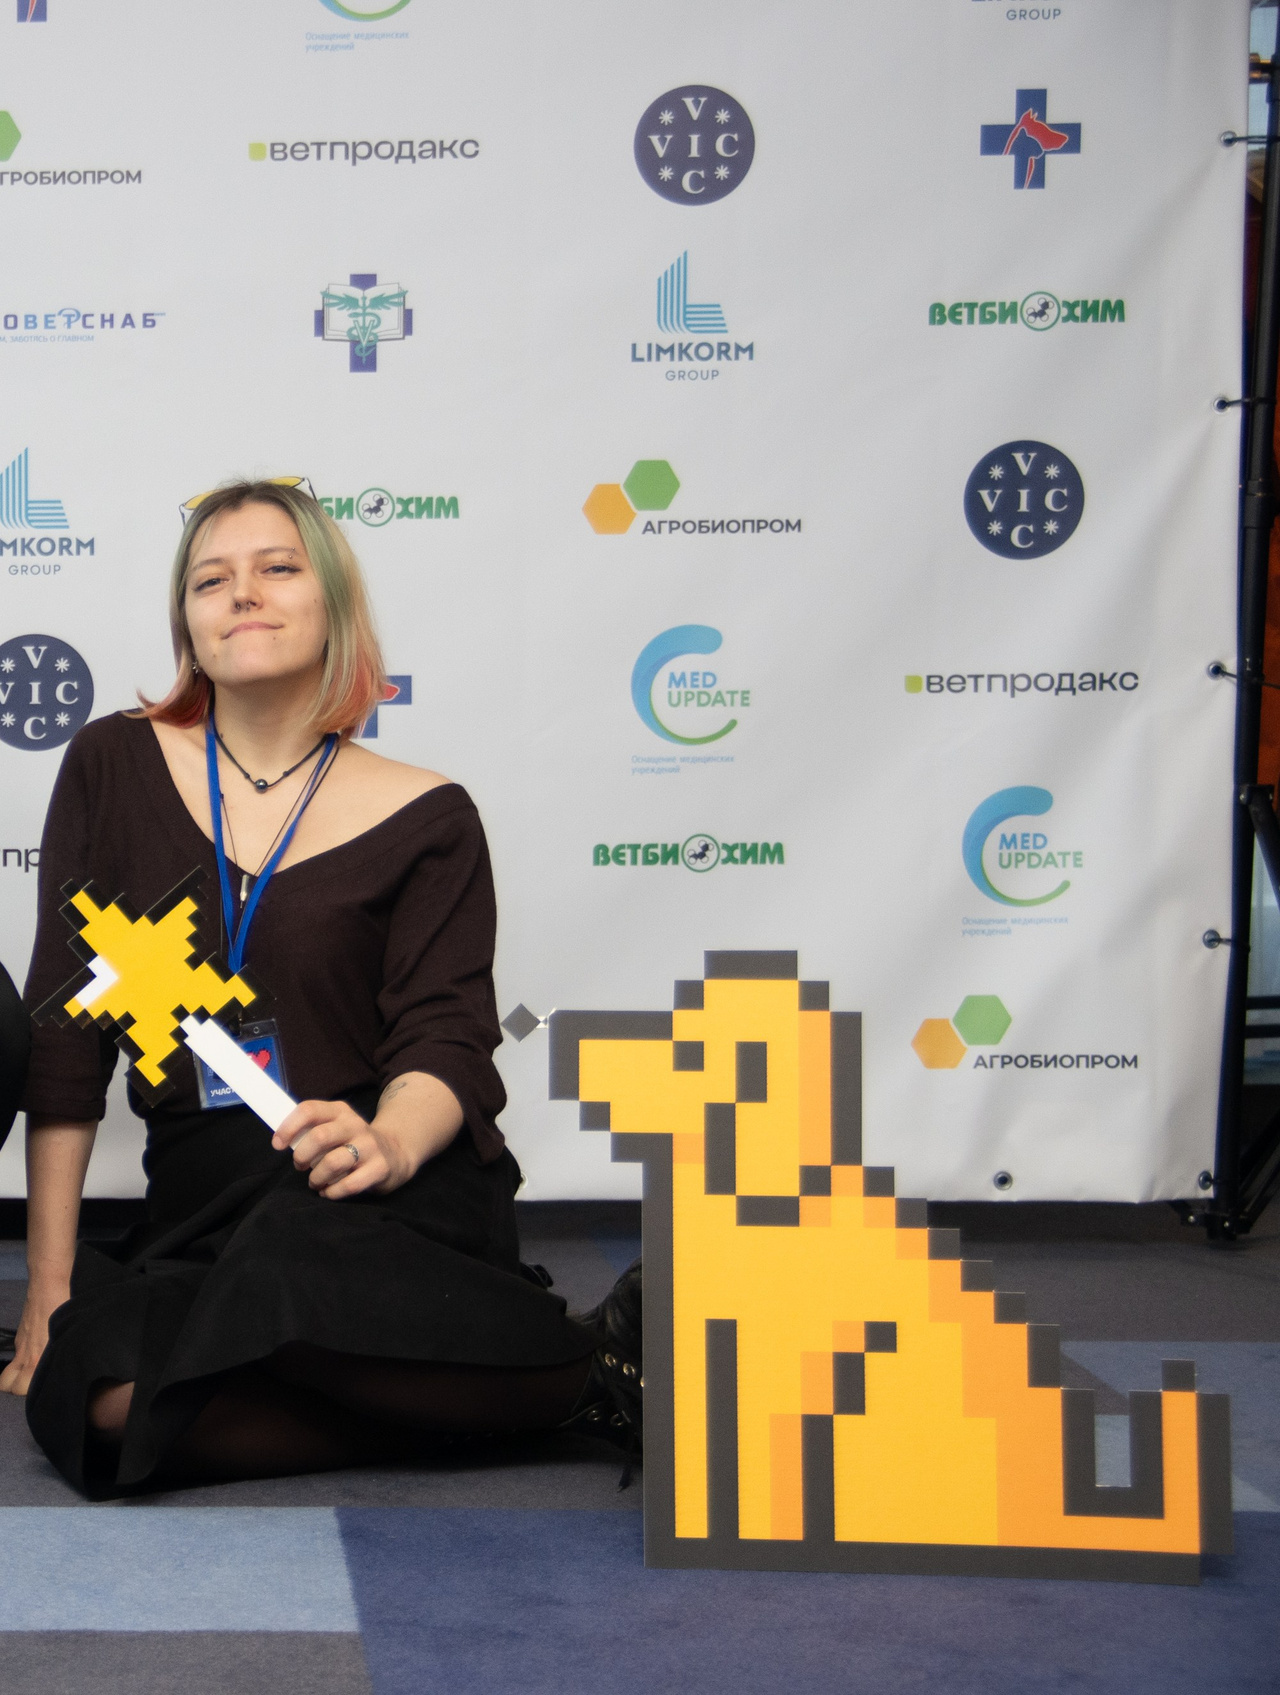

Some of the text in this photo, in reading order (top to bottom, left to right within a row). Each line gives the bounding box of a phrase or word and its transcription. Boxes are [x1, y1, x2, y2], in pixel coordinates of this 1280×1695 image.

[1005, 7, 1062, 21] GROUP
[269, 138, 480, 167] ветпродакс
[631, 341, 755, 363] LIMKORM
[664, 368, 721, 382] GROUP
[319, 487, 459, 527] БИОХИМ
[642, 518, 803, 535] АГРОБИОПРОМ
[7, 563, 62, 576] GROUP
[667, 670, 718, 689] MED
[925, 671, 1140, 698] ветпродакс
[667, 688, 751, 708] UPDATE
[998, 832, 1048, 851] MED
[997, 848, 1083, 871] UPDATE
[974, 1053, 1139, 1070] АГРОБИОПРОМ
